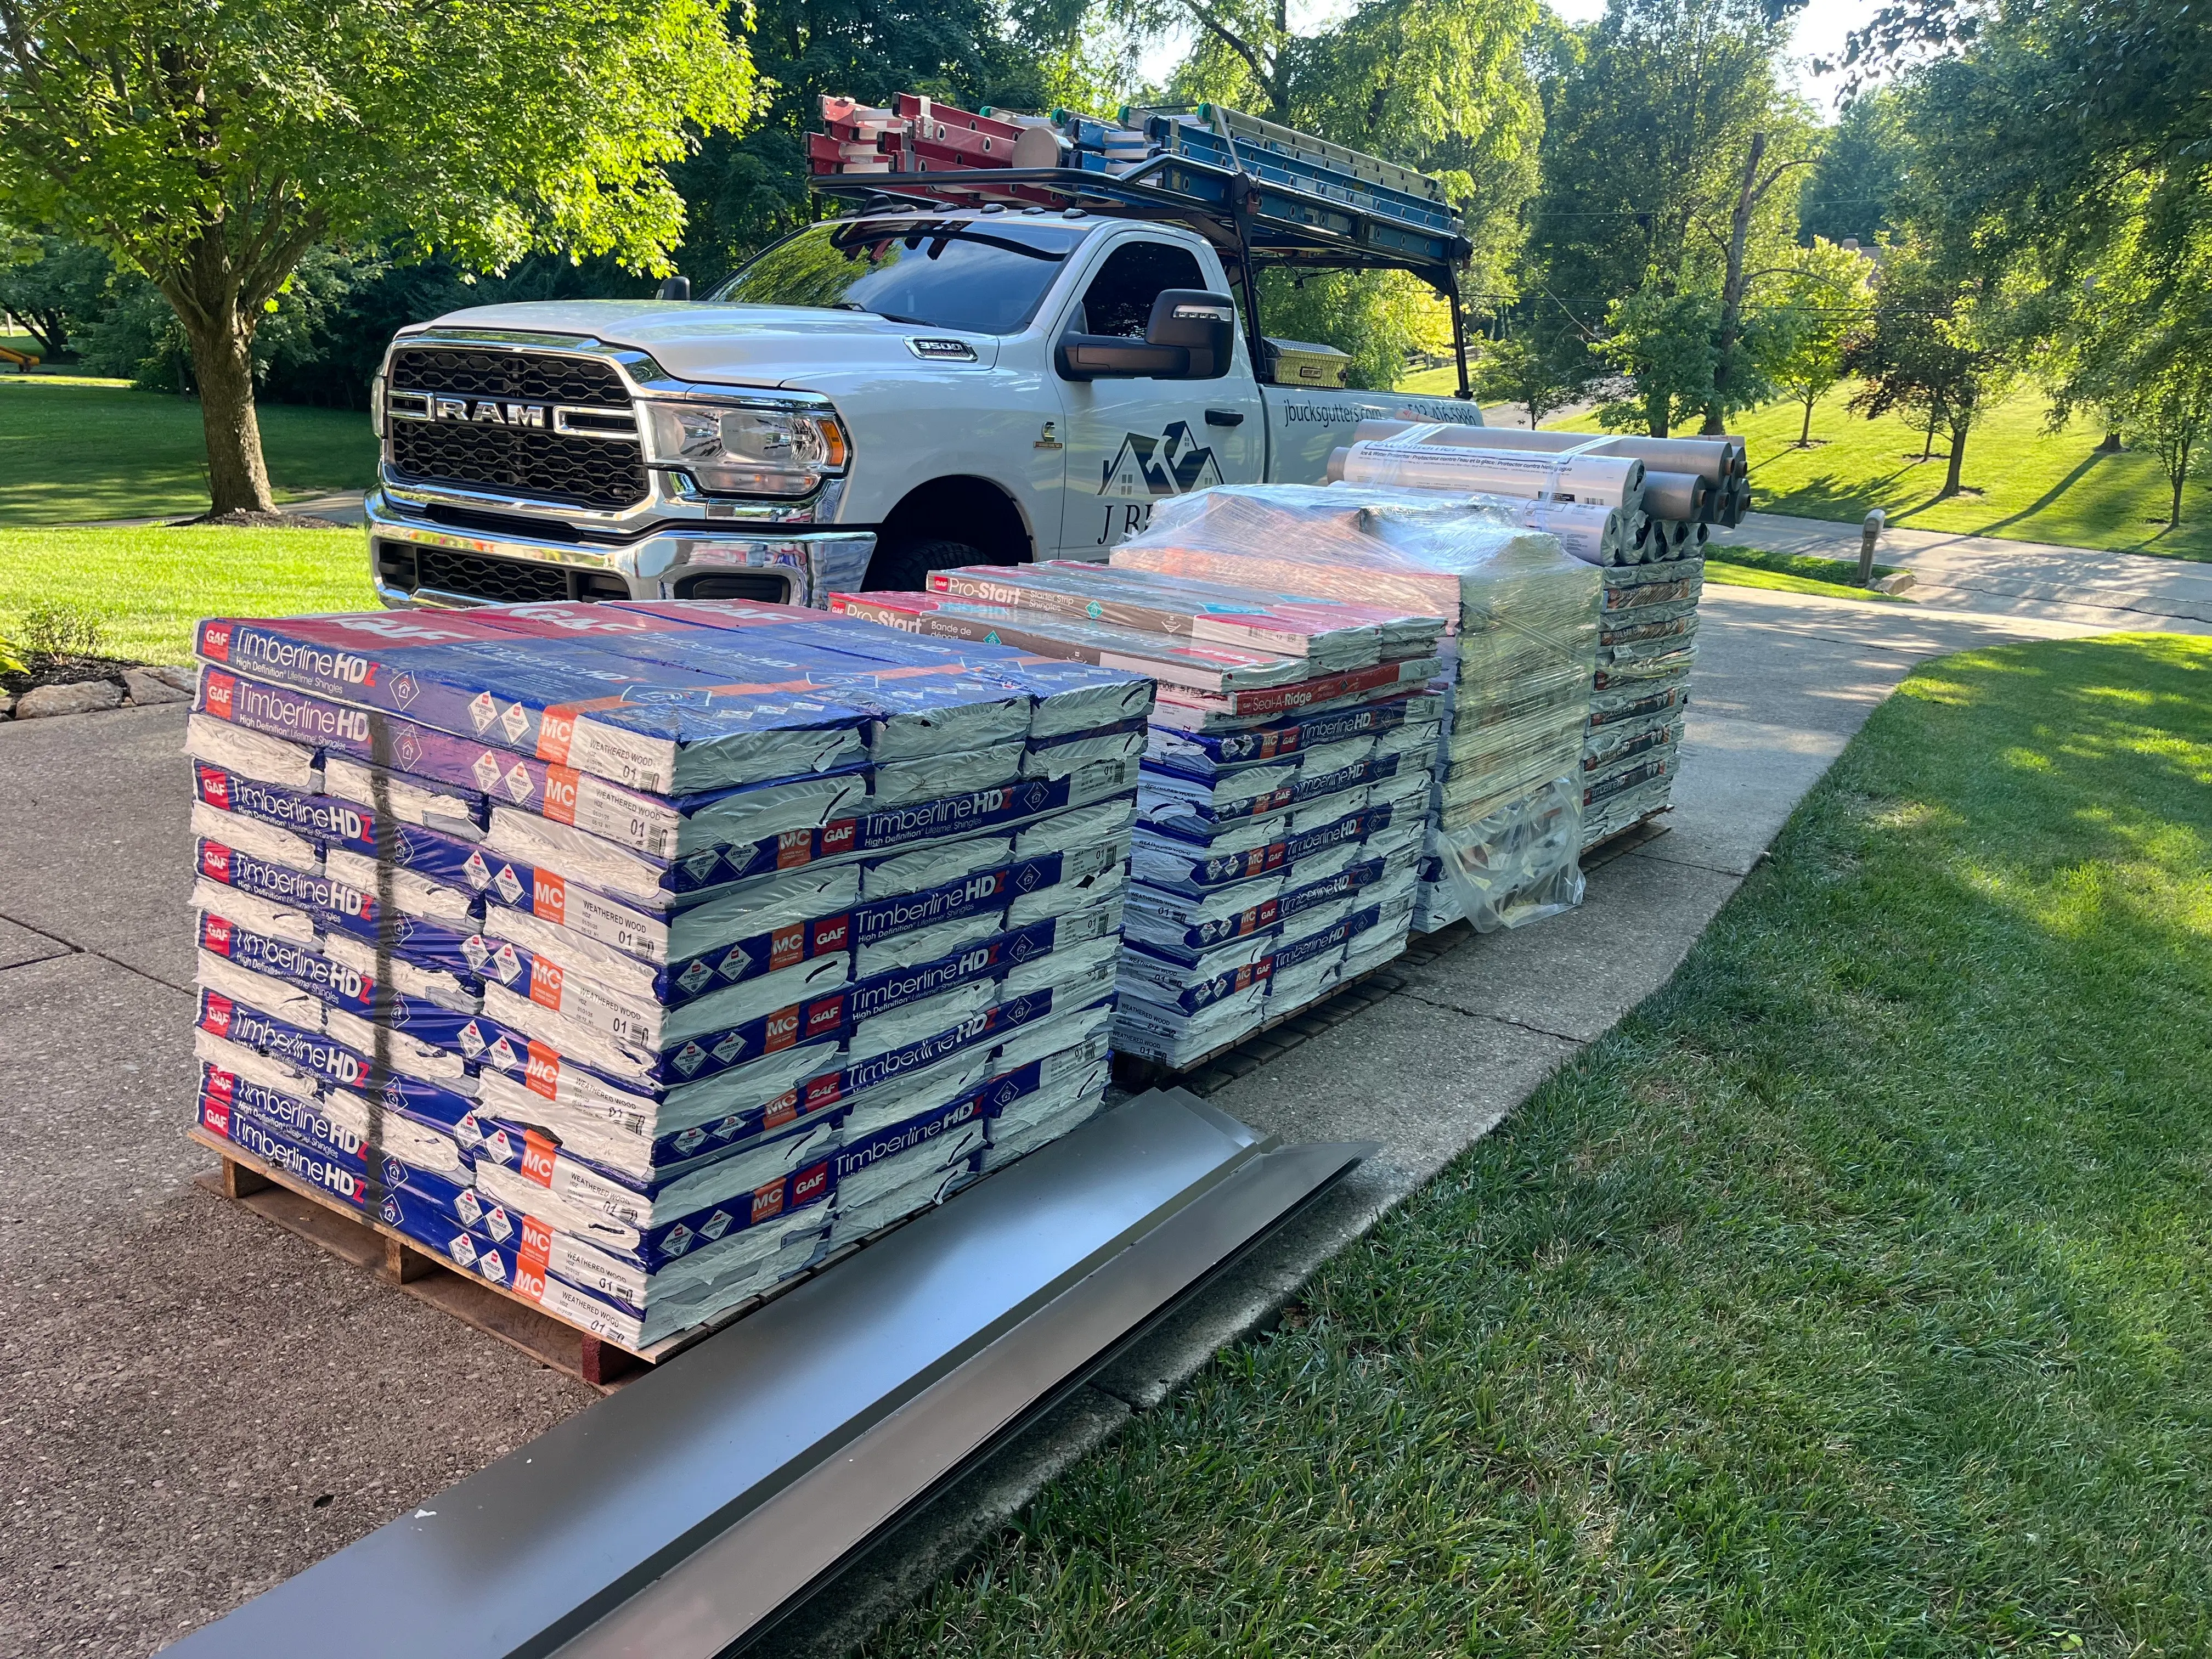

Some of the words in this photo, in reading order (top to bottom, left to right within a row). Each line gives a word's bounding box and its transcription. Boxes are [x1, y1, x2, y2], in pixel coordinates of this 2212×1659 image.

[919, 342, 963, 351] 3500
[437, 397, 545, 428] RAM
[1284, 400, 1382, 427] jbucksgutters.com
[1097, 505, 1114, 545] J
[936, 580, 947, 588] GAF
[950, 577, 1021, 605] Pro-Start
[1057, 593, 1074, 605] Strip
[832, 606, 844, 614] GAF
[931, 620, 958, 634] Bande
[960, 625, 972, 635] de
[206, 630, 229, 646] GAF
[236, 656, 251, 671] High
[315, 678, 343, 694] Shingles
[1253, 691, 1312, 711] Seal-A-Ridge
[208, 686, 231, 703] GAF
[336, 709, 373, 744] HD
[240, 714, 255, 727] High
[318, 737, 346, 751] Shingles
[541, 717, 571, 742] MC
[1263, 736, 1277, 747] MC
[1283, 736, 1296, 745] GAF
[590, 740, 630, 760] WEATHERED
[631, 752, 653, 766] WOOD
[623, 765, 636, 780] 01
[1104, 765, 1114, 776] 01
[204, 779, 225, 795] GAF
[546, 778, 575, 806] MC
[1275, 791, 1290, 799] GAF
[238, 805, 253, 819] High
[596, 789, 637, 812] WEATHERED
[637, 805, 661, 821] WOOD
[631, 819, 645, 837] 01
[779, 830, 810, 850] MC
[824, 826, 853, 843] GAF
[865, 837, 883, 847] High
[953, 817, 982, 829] Shingles
[205, 851, 228, 870] GAF
[1096, 848, 1105, 860] 01
[1249, 853, 1263, 865] MC
[1268, 852, 1283, 862] GAF
[238, 881, 253, 892] High
[535, 882, 563, 908] MC
[1131, 891, 1163, 904] WEATHERED
[583, 899, 623, 926] WEATHERED
[624, 919, 646, 934] WOOD
[1158, 907, 1170, 916] 01
[1242, 911, 1256, 924] MC
[1261, 907, 1276, 919] GAF
[207, 923, 228, 940] GAF
[858, 933, 876, 943] High
[946, 903, 974, 919] Shingles
[618, 930, 632, 946] 01
[772, 933, 803, 955] MC
[816, 927, 846, 945] GAF
[533, 961, 562, 989] MC
[1129, 956, 1160, 972] WEATHERED
[1161, 967, 1177, 976] WOOD
[1236, 968, 1251, 981] MC
[1256, 963, 1271, 975] GAF
[236, 952, 252, 968] High
[312, 983, 340, 1005] Shingles
[580, 986, 619, 1012] WEATHERED
[620, 1006, 641, 1020] WOOD
[208, 1007, 229, 1026] GAF
[768, 1015, 798, 1037] MC
[810, 1006, 839, 1025] GAF
[853, 1008, 871, 1020] High
[1121, 1003, 1153, 1019] WEATHERED
[1154, 1015, 1170, 1025] WOOD
[613, 1018, 627, 1034] 01
[1113, 1030, 1143, 1044] WEATHERED
[1144, 1040, 1160, 1048] WOOD
[527, 1058, 557, 1084] MC
[576, 1078, 614, 1103] WEATHERED
[614, 1097, 636, 1109] WOOD
[766, 1093, 797, 1115] MC
[808, 1082, 837, 1100] GAF
[206, 1109, 227, 1128] GAF
[238, 1102, 252, 1115] High
[608, 1107, 622, 1118] 01
[312, 1139, 338, 1159] Shingles
[523, 1150, 551, 1177] MC
[571, 1171, 609, 1197] WEATHERED
[610, 1193, 630, 1205] WOOD
[753, 1188, 783, 1212] MC
[795, 1173, 825, 1194] GAF
[603, 1200, 616, 1212] 01
[523, 1226, 549, 1251] MC
[567, 1250, 605, 1274] WEATHERED
[606, 1271, 627, 1283] WOOD
[516, 1271, 543, 1298] MC
[600, 1278, 612, 1291] 01
[562, 1291, 600, 1316] WEATHERED
[600, 1312, 619, 1328] WOOD
[591, 1320, 605, 1334] 01
